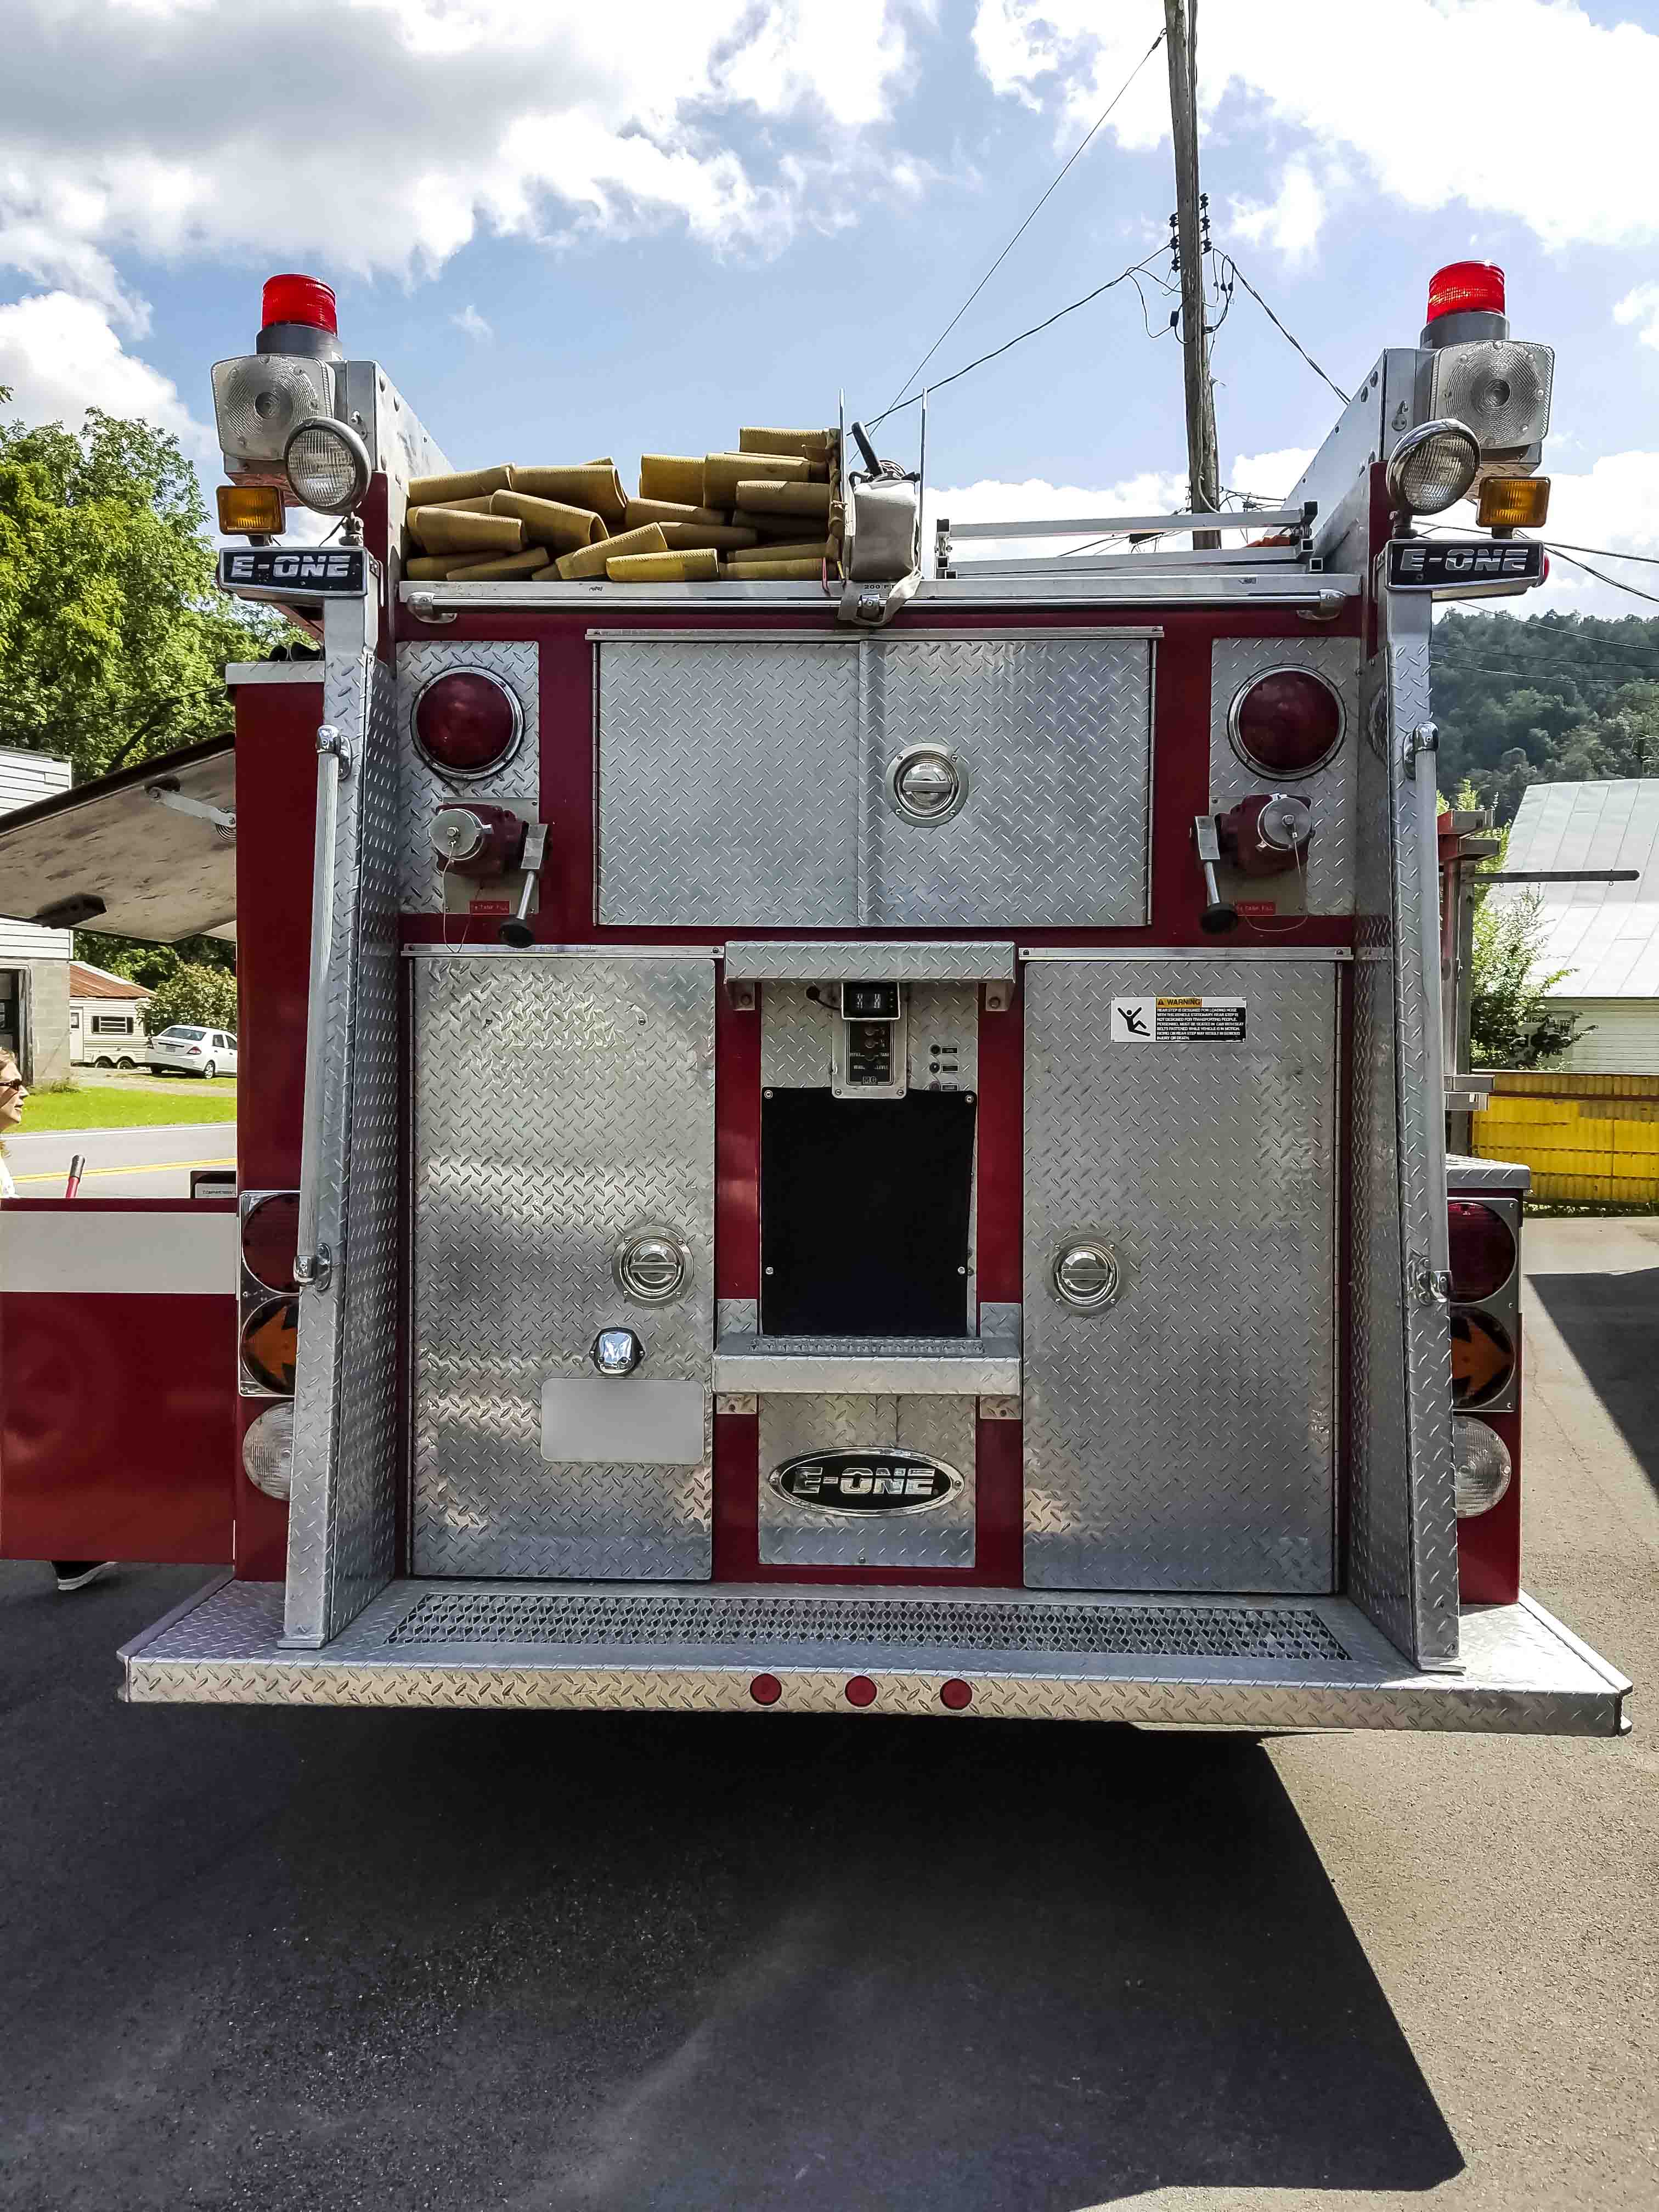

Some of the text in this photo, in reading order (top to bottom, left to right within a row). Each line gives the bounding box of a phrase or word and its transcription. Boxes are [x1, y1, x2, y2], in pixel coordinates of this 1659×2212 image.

[231, 556, 351, 577] E-ONE
[1400, 549, 1528, 571] E-ONE
[792, 1466, 935, 1495] E-ONE
